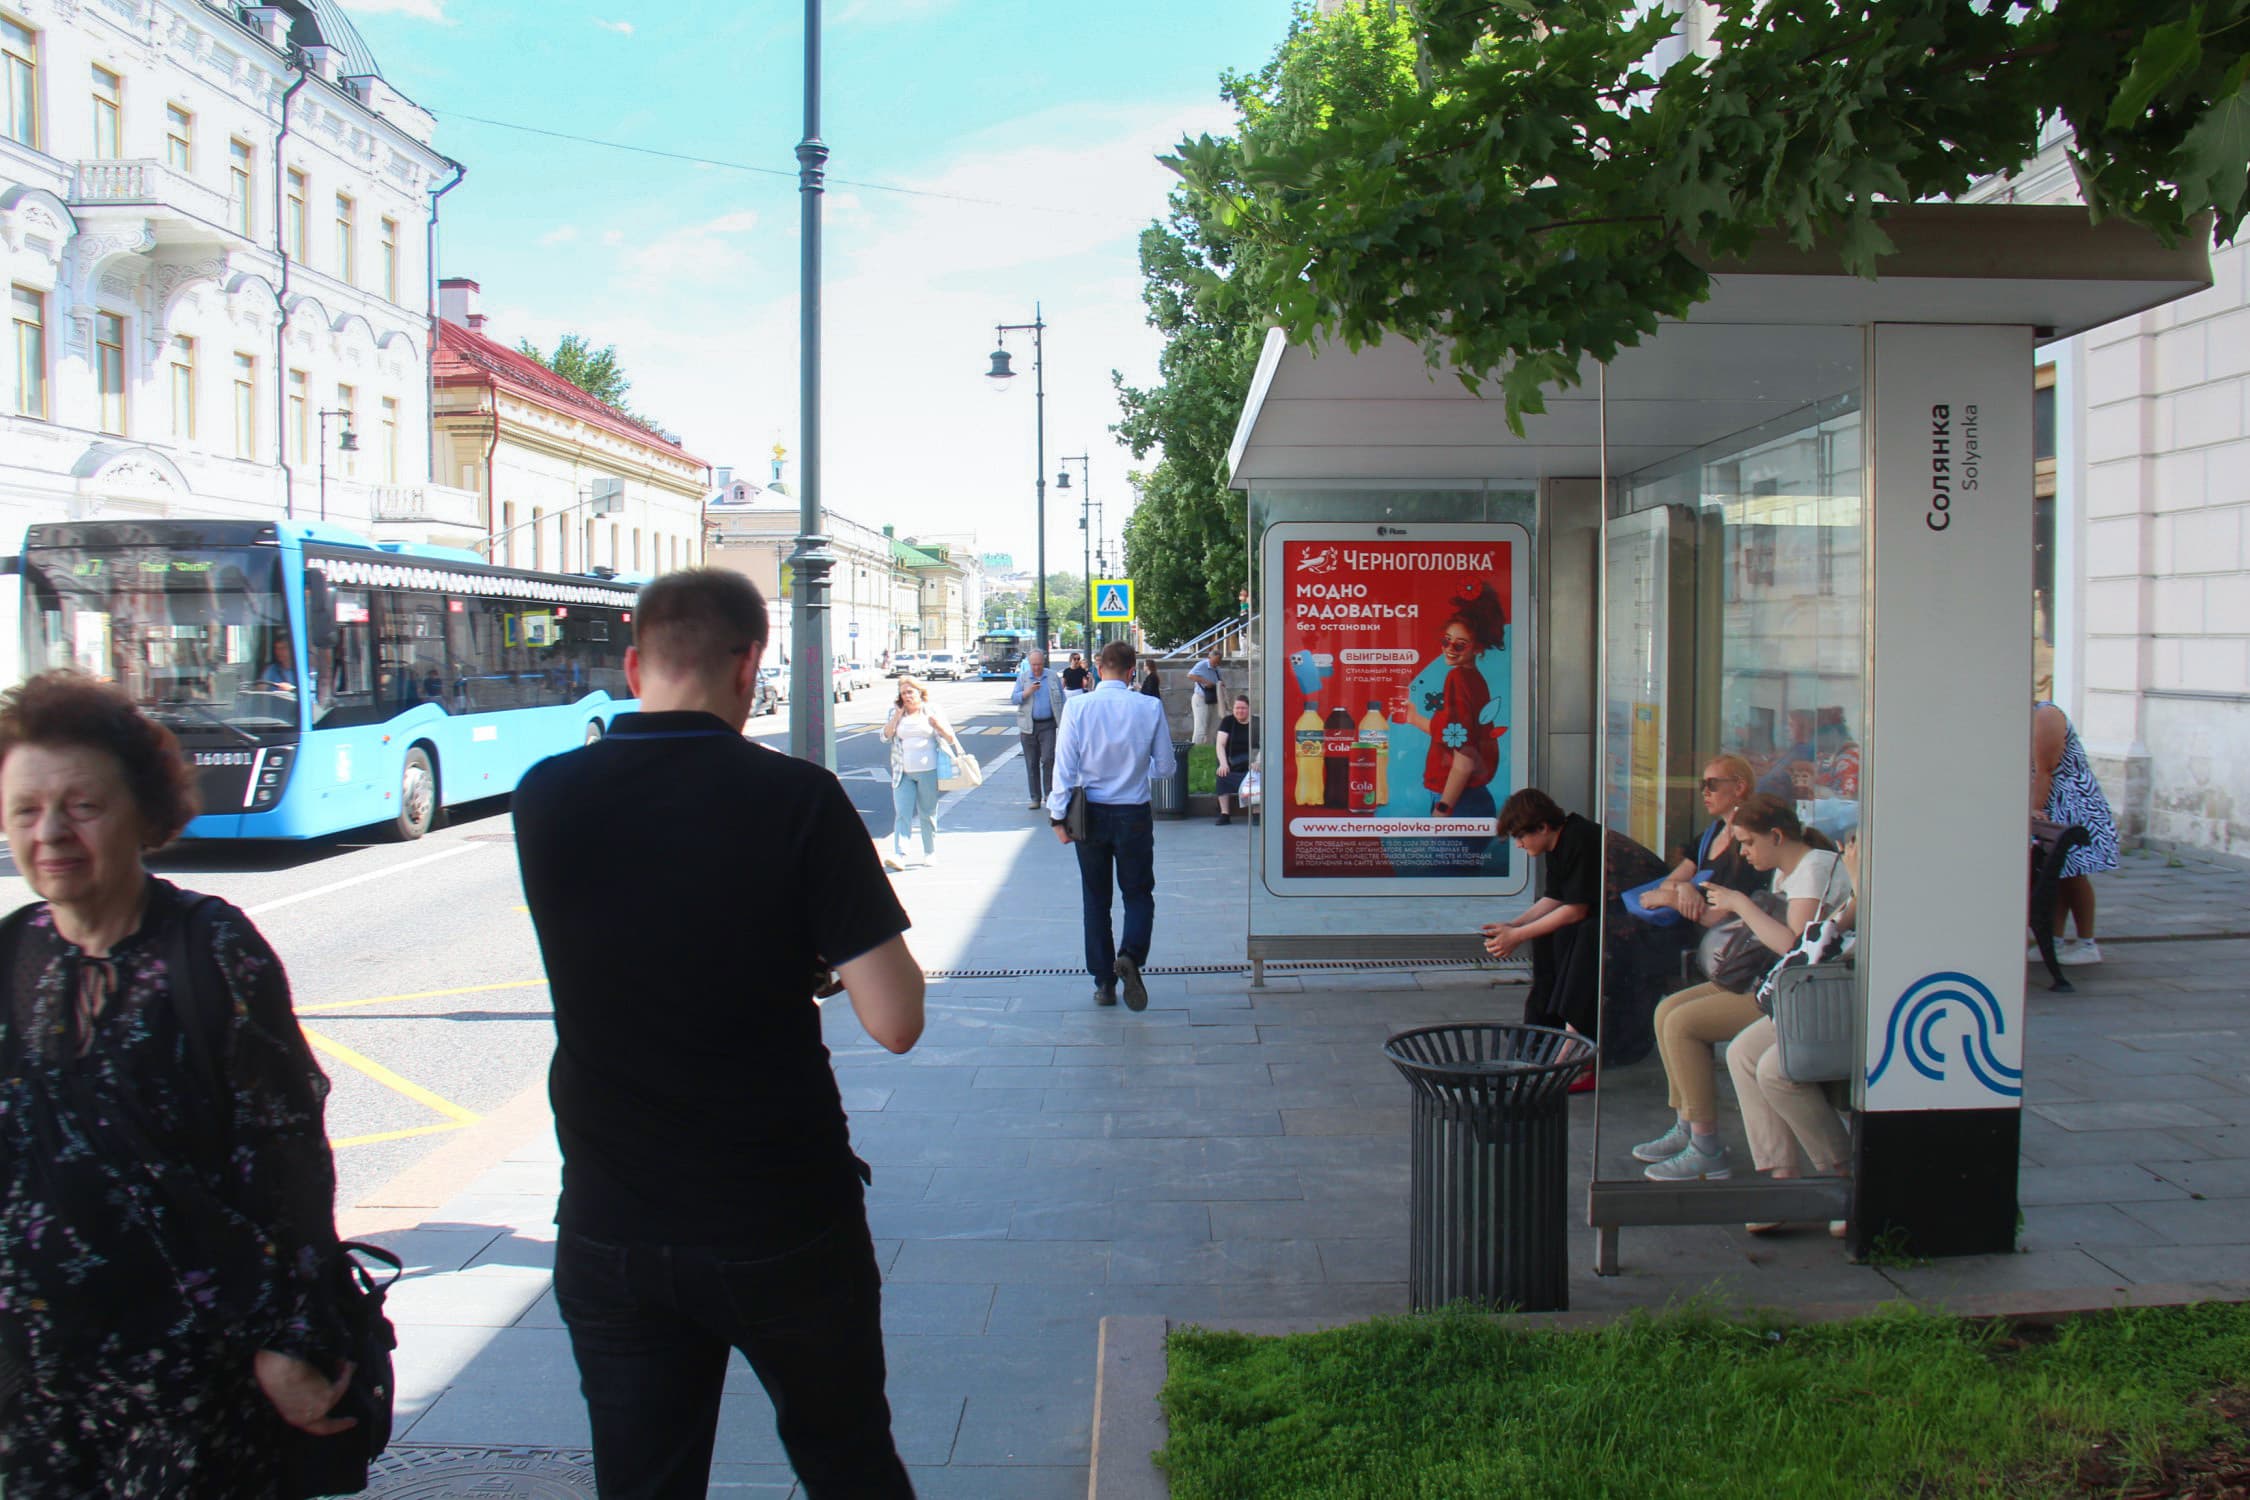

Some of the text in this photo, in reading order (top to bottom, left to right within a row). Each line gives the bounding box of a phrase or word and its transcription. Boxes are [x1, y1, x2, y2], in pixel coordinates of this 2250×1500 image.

[1961, 404, 1981, 491] Solyanka
[1926, 403, 1951, 532] Солянка
[1343, 549, 1493, 571] ЧЕРНОГОЛОВКА
[1296, 583, 1368, 600] МОДНО
[1296, 603, 1419, 620] РАДОВАТЬСЯ
[1296, 621, 1381, 631] без остановки
[1346, 650, 1414, 662] ВЫИГРЫВАЙ
[1327, 742, 1350, 752] Cola
[1350, 780, 1373, 791] Cola
[1303, 821, 1490, 834] www.chernogolovka-promo.ru
